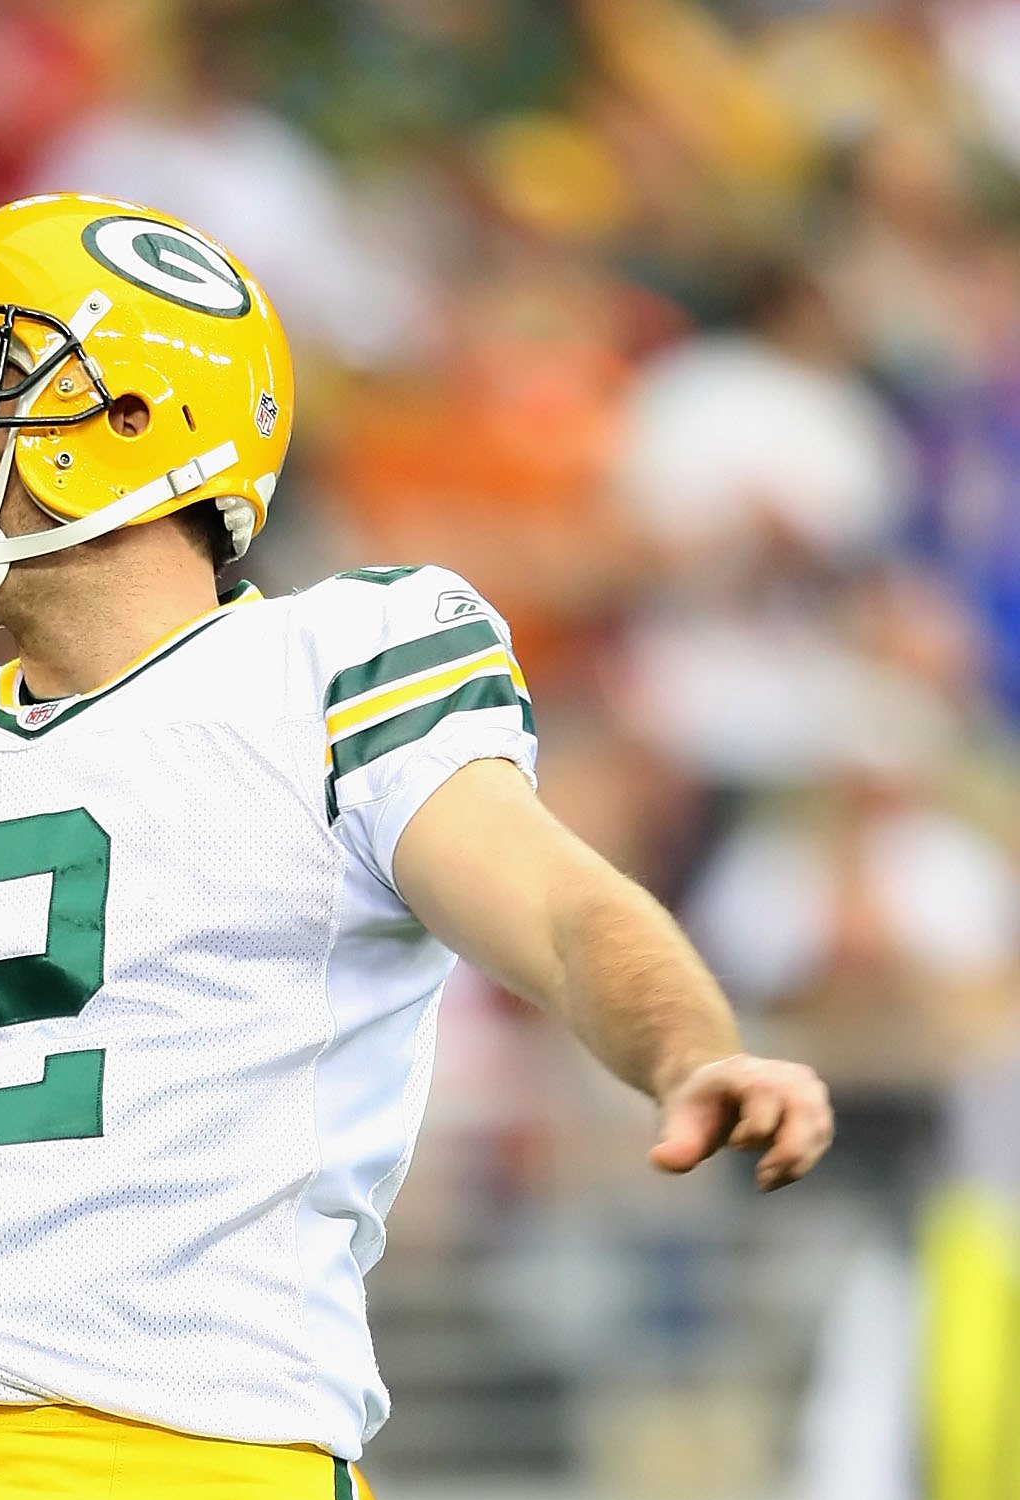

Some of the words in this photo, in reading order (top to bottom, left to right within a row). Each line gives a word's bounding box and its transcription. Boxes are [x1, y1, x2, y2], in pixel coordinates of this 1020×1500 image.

[90, 218, 247, 314] G
[257, 407, 273, 433] NFL
[28, 709, 51, 722] NFL
